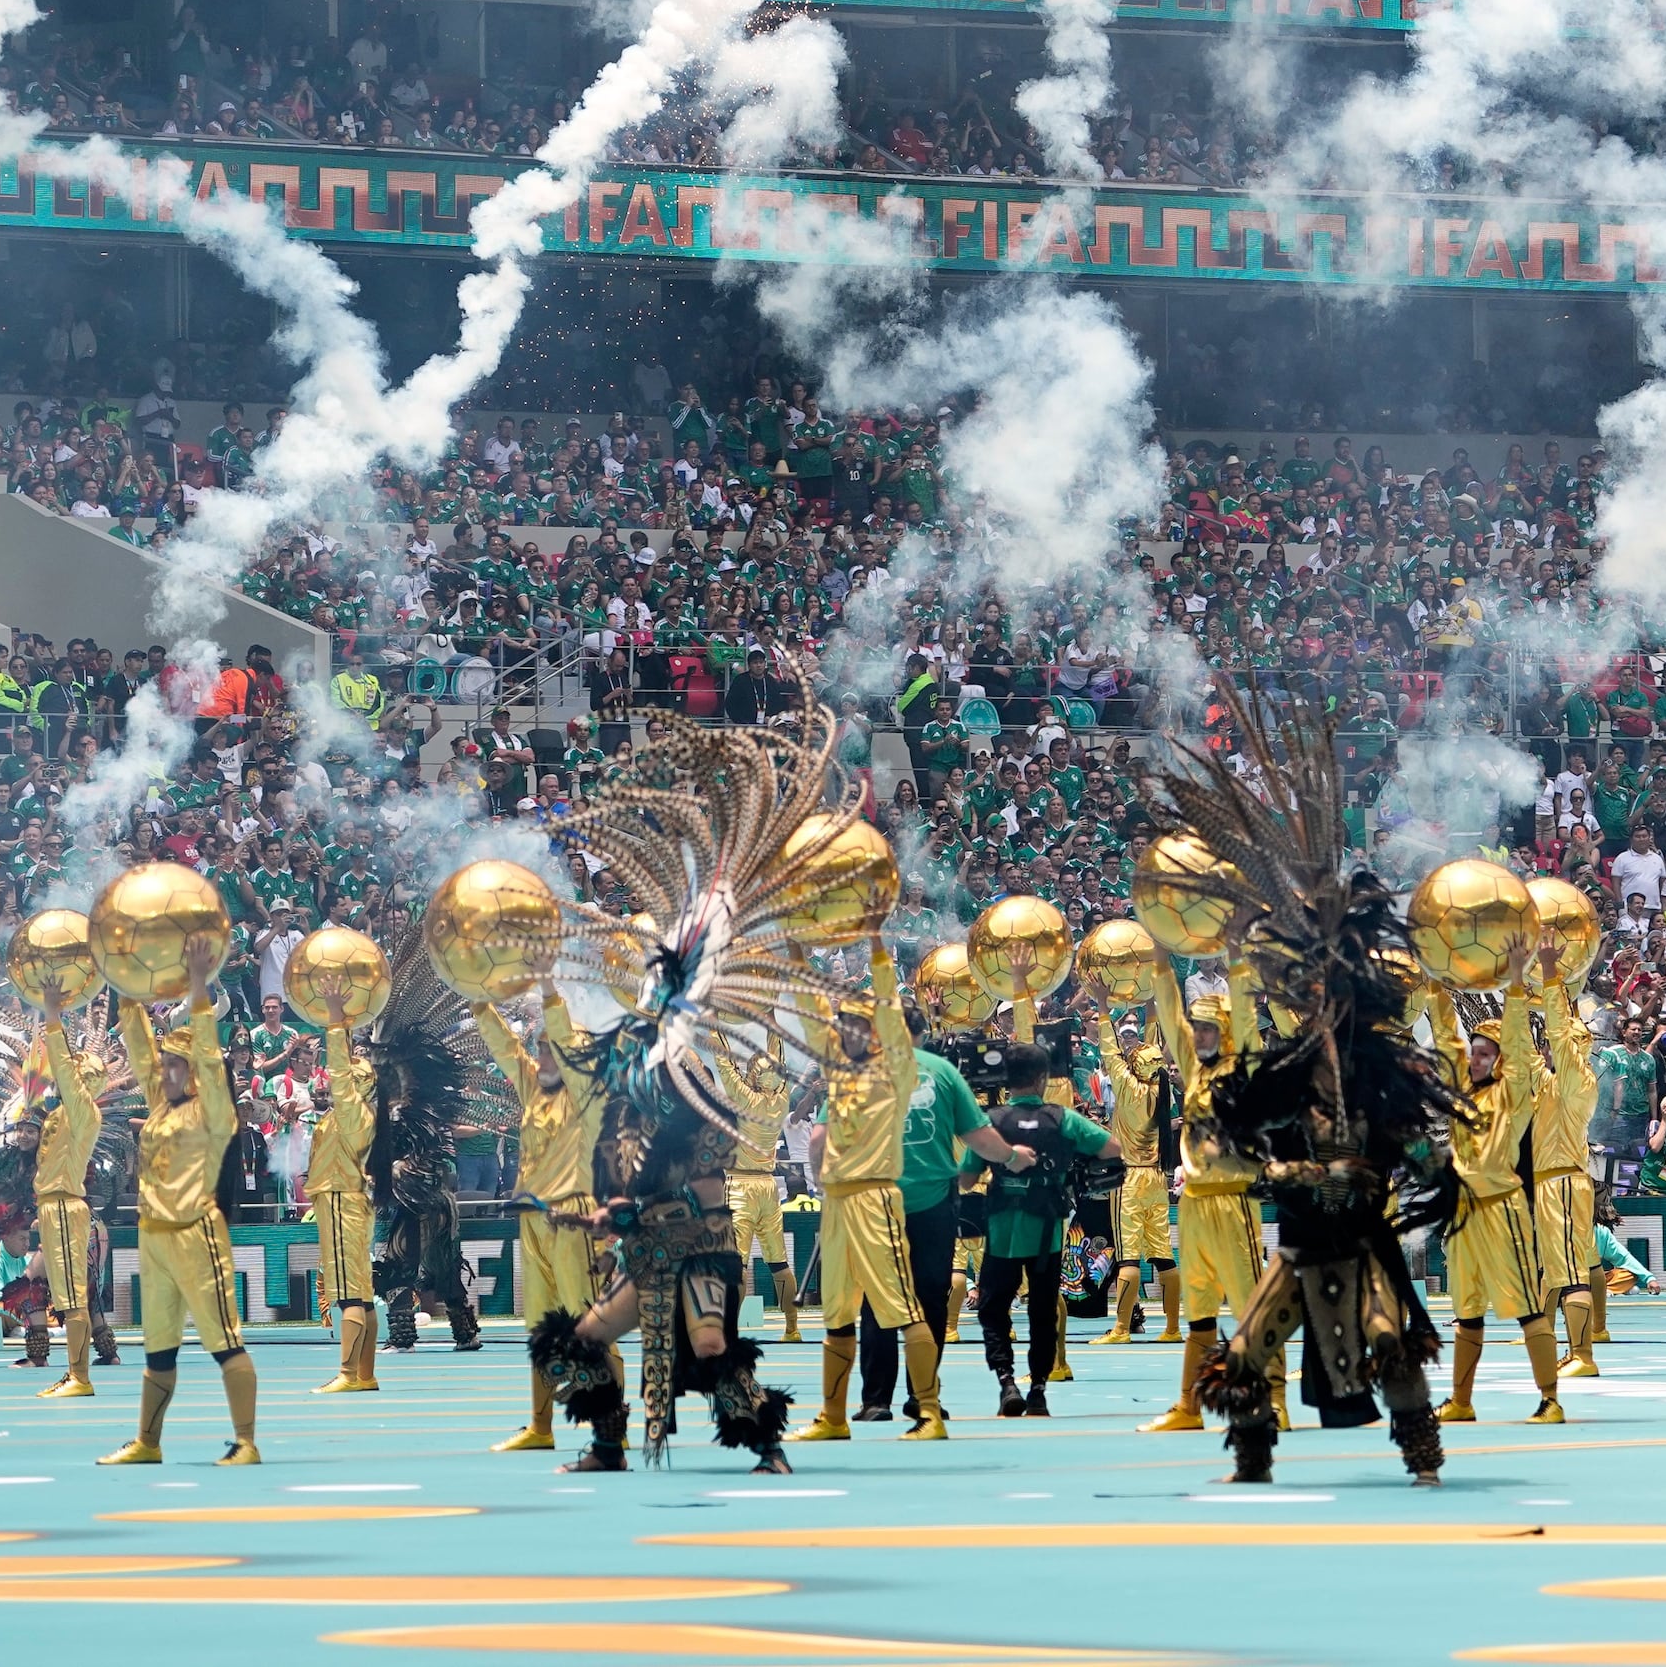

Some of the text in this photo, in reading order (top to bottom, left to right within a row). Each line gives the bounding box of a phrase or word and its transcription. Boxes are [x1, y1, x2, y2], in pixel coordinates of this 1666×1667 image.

[563, 182, 669, 246] IFA
[943, 199, 1086, 264] FIFA
[849, 470, 861, 482] 10
[978, 786, 986, 798] 7
[937, 869, 945, 882] 9
